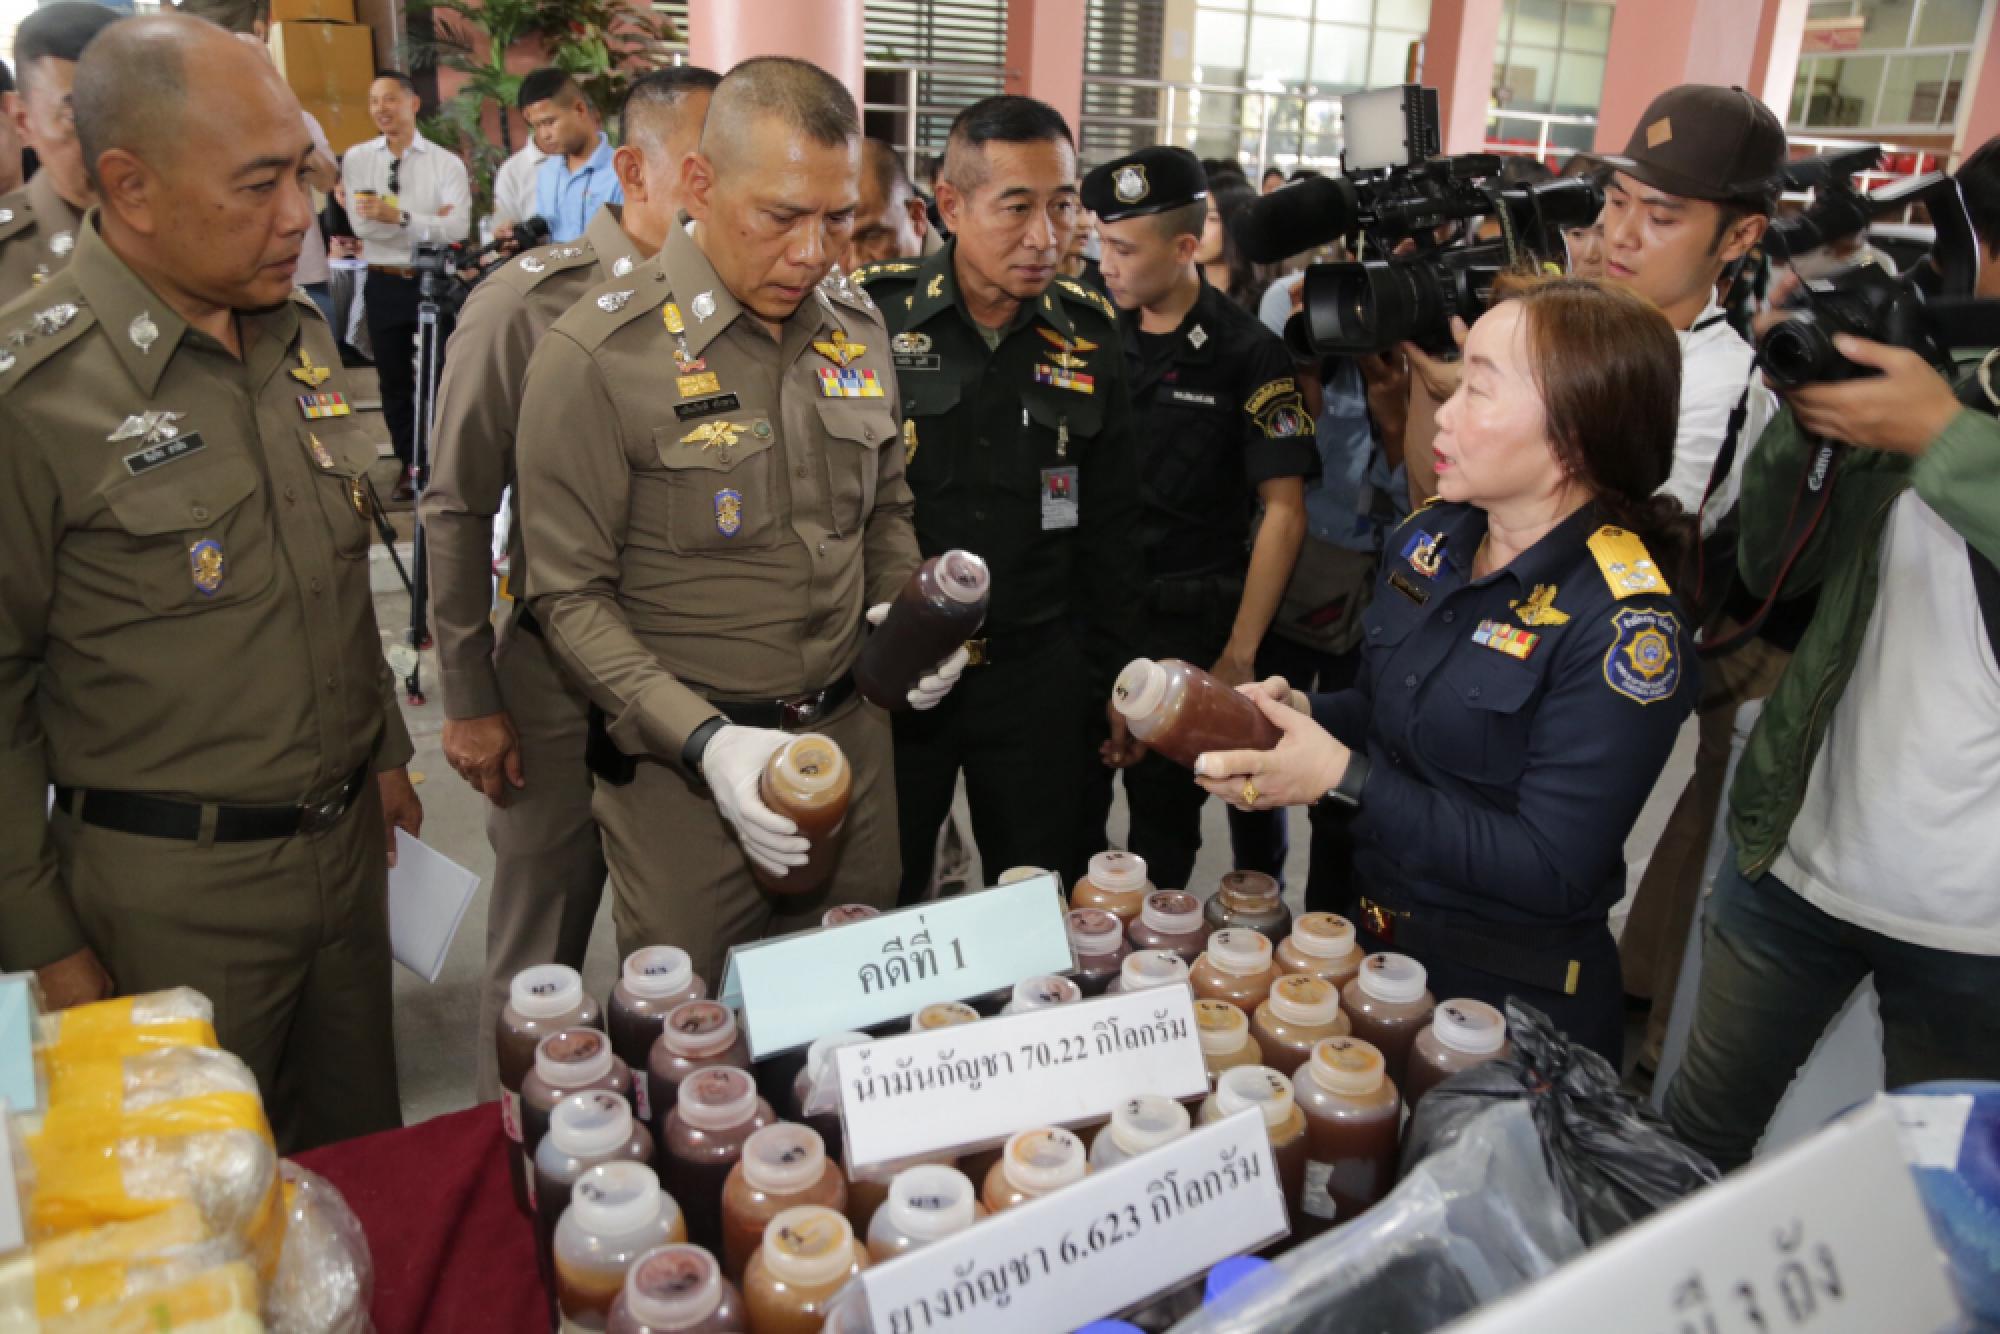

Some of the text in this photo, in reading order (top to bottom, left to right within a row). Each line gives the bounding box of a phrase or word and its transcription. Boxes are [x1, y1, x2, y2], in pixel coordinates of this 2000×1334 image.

[1808, 447, 1833, 492] Cano
[858, 914, 967, 994] คดีที่ 1
[853, 1010, 1189, 1102] น้ำมันกัญชา 70.22 กิโลกรัม
[889, 1145, 1262, 1334] ยางกัญชา 6.623 กิโลกรัม
